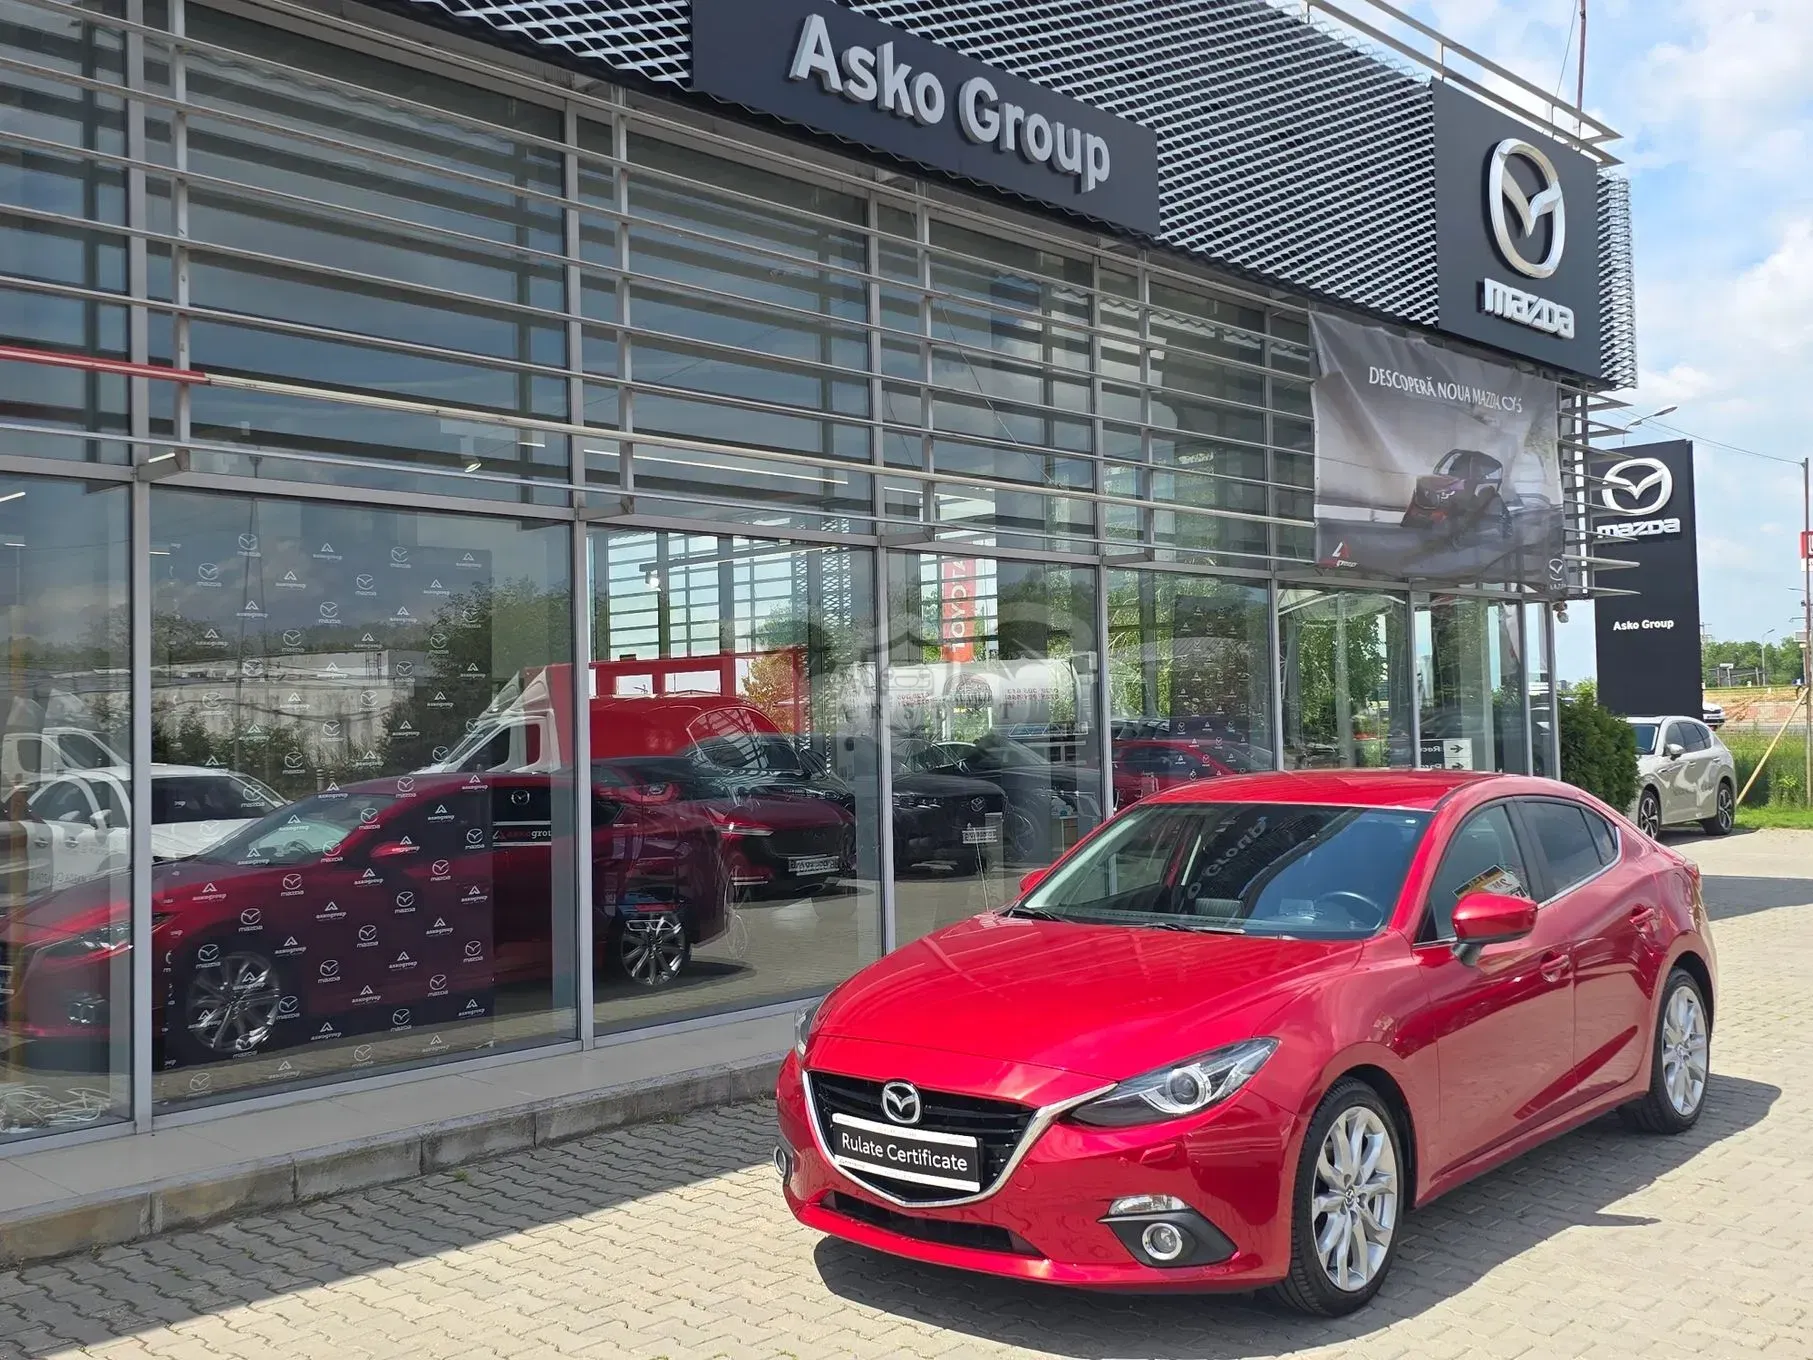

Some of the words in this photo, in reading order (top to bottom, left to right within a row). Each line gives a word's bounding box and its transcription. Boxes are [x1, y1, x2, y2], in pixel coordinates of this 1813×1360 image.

[789, 13, 945, 126] Asko
[958, 76, 1110, 193] Group
[1484, 277, 1574, 339] mazda
[1369, 366, 1437, 397] DESCOPERĂ
[1437, 382, 1471, 404] NOUA
[1472, 387, 1502, 410] MAZDA
[1597, 518, 1680, 538] mazda
[1613, 621, 1639, 631] Asko
[1641, 619, 1674, 630] Group
[842, 1133, 884, 1157] Rulate
[886, 1144, 968, 1172] Certificate
